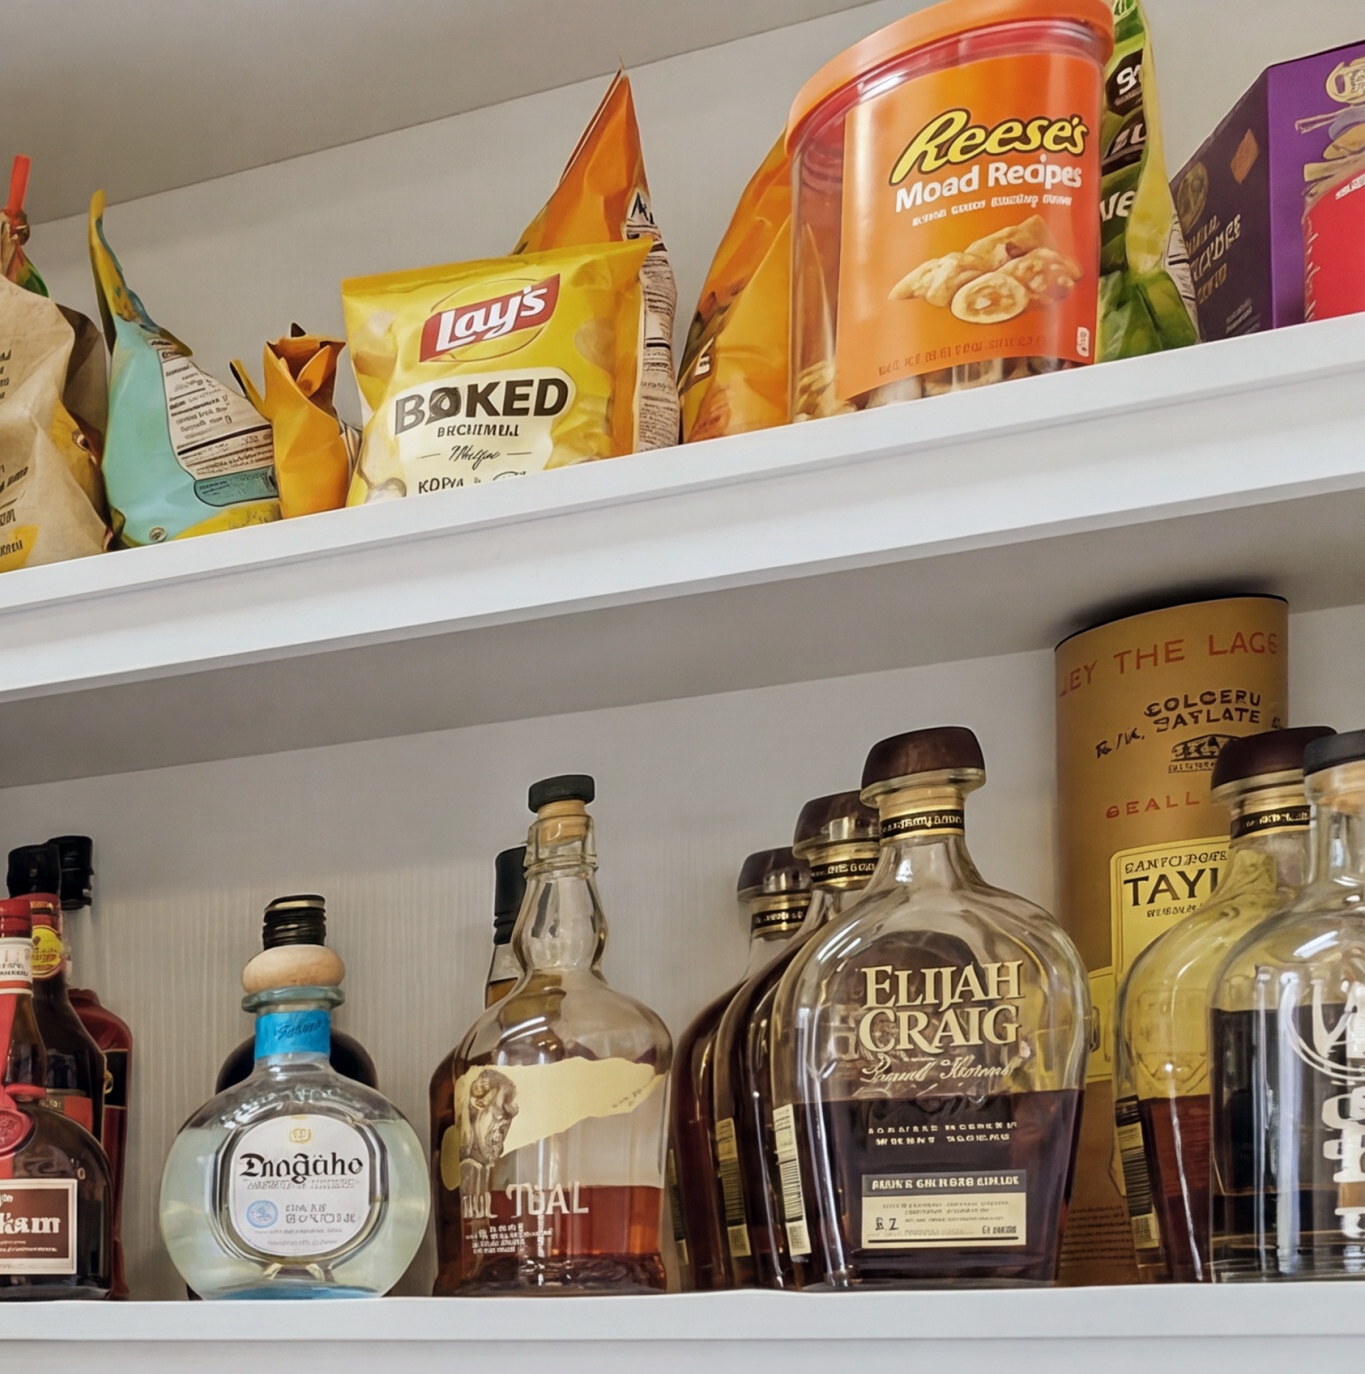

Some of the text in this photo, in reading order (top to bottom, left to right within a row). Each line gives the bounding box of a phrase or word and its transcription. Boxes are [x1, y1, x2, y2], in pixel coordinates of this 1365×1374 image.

[434, 284, 549, 352] Lay's
[1113, 638, 1186, 676] THE
[859, 960, 1026, 1012] ELIJAH
[857, 1003, 1021, 1055] CRAIG
